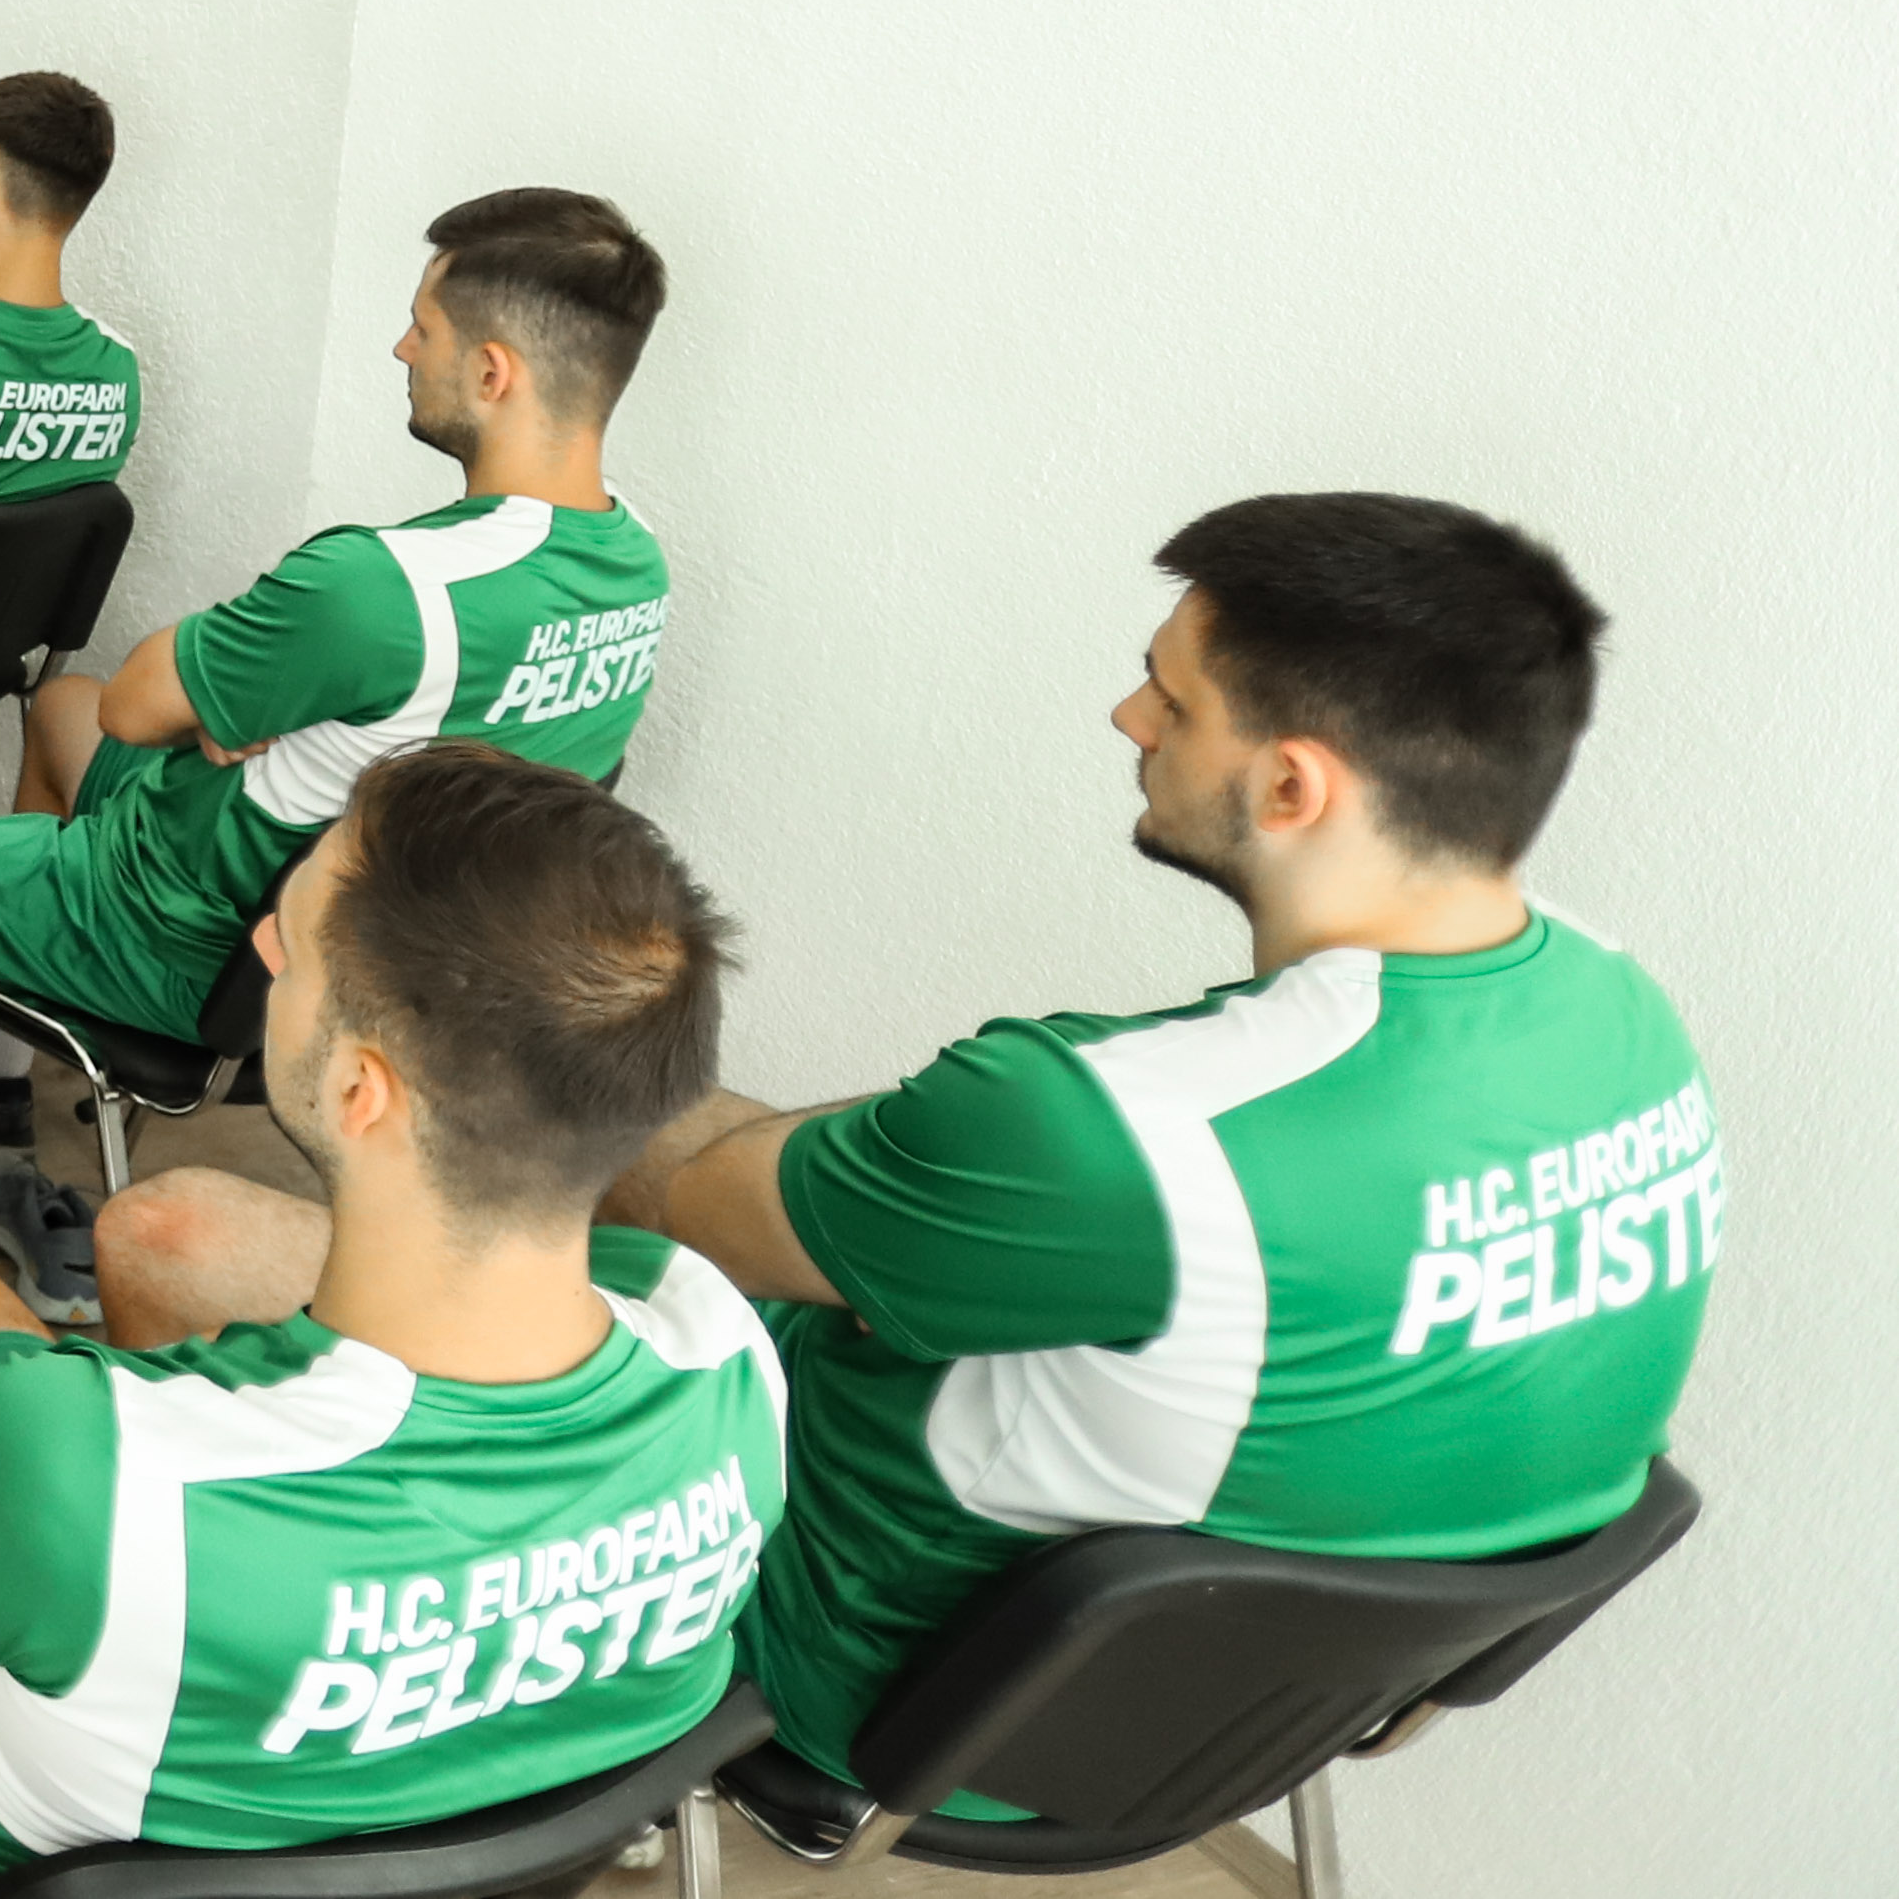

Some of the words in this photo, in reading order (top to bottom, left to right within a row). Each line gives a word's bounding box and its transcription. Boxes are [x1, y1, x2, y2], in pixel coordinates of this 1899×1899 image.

[483, 629, 663, 725] PELISTE
[572, 593, 670, 653] EUROFA
[1388, 1133, 1727, 1356] PELISTE
[1424, 1167, 1529, 1248] H.C.
[326, 1575, 454, 1657] H.C.
[461, 1453, 754, 1633] EUROFARM
[260, 1521, 764, 1756] PELISTER
